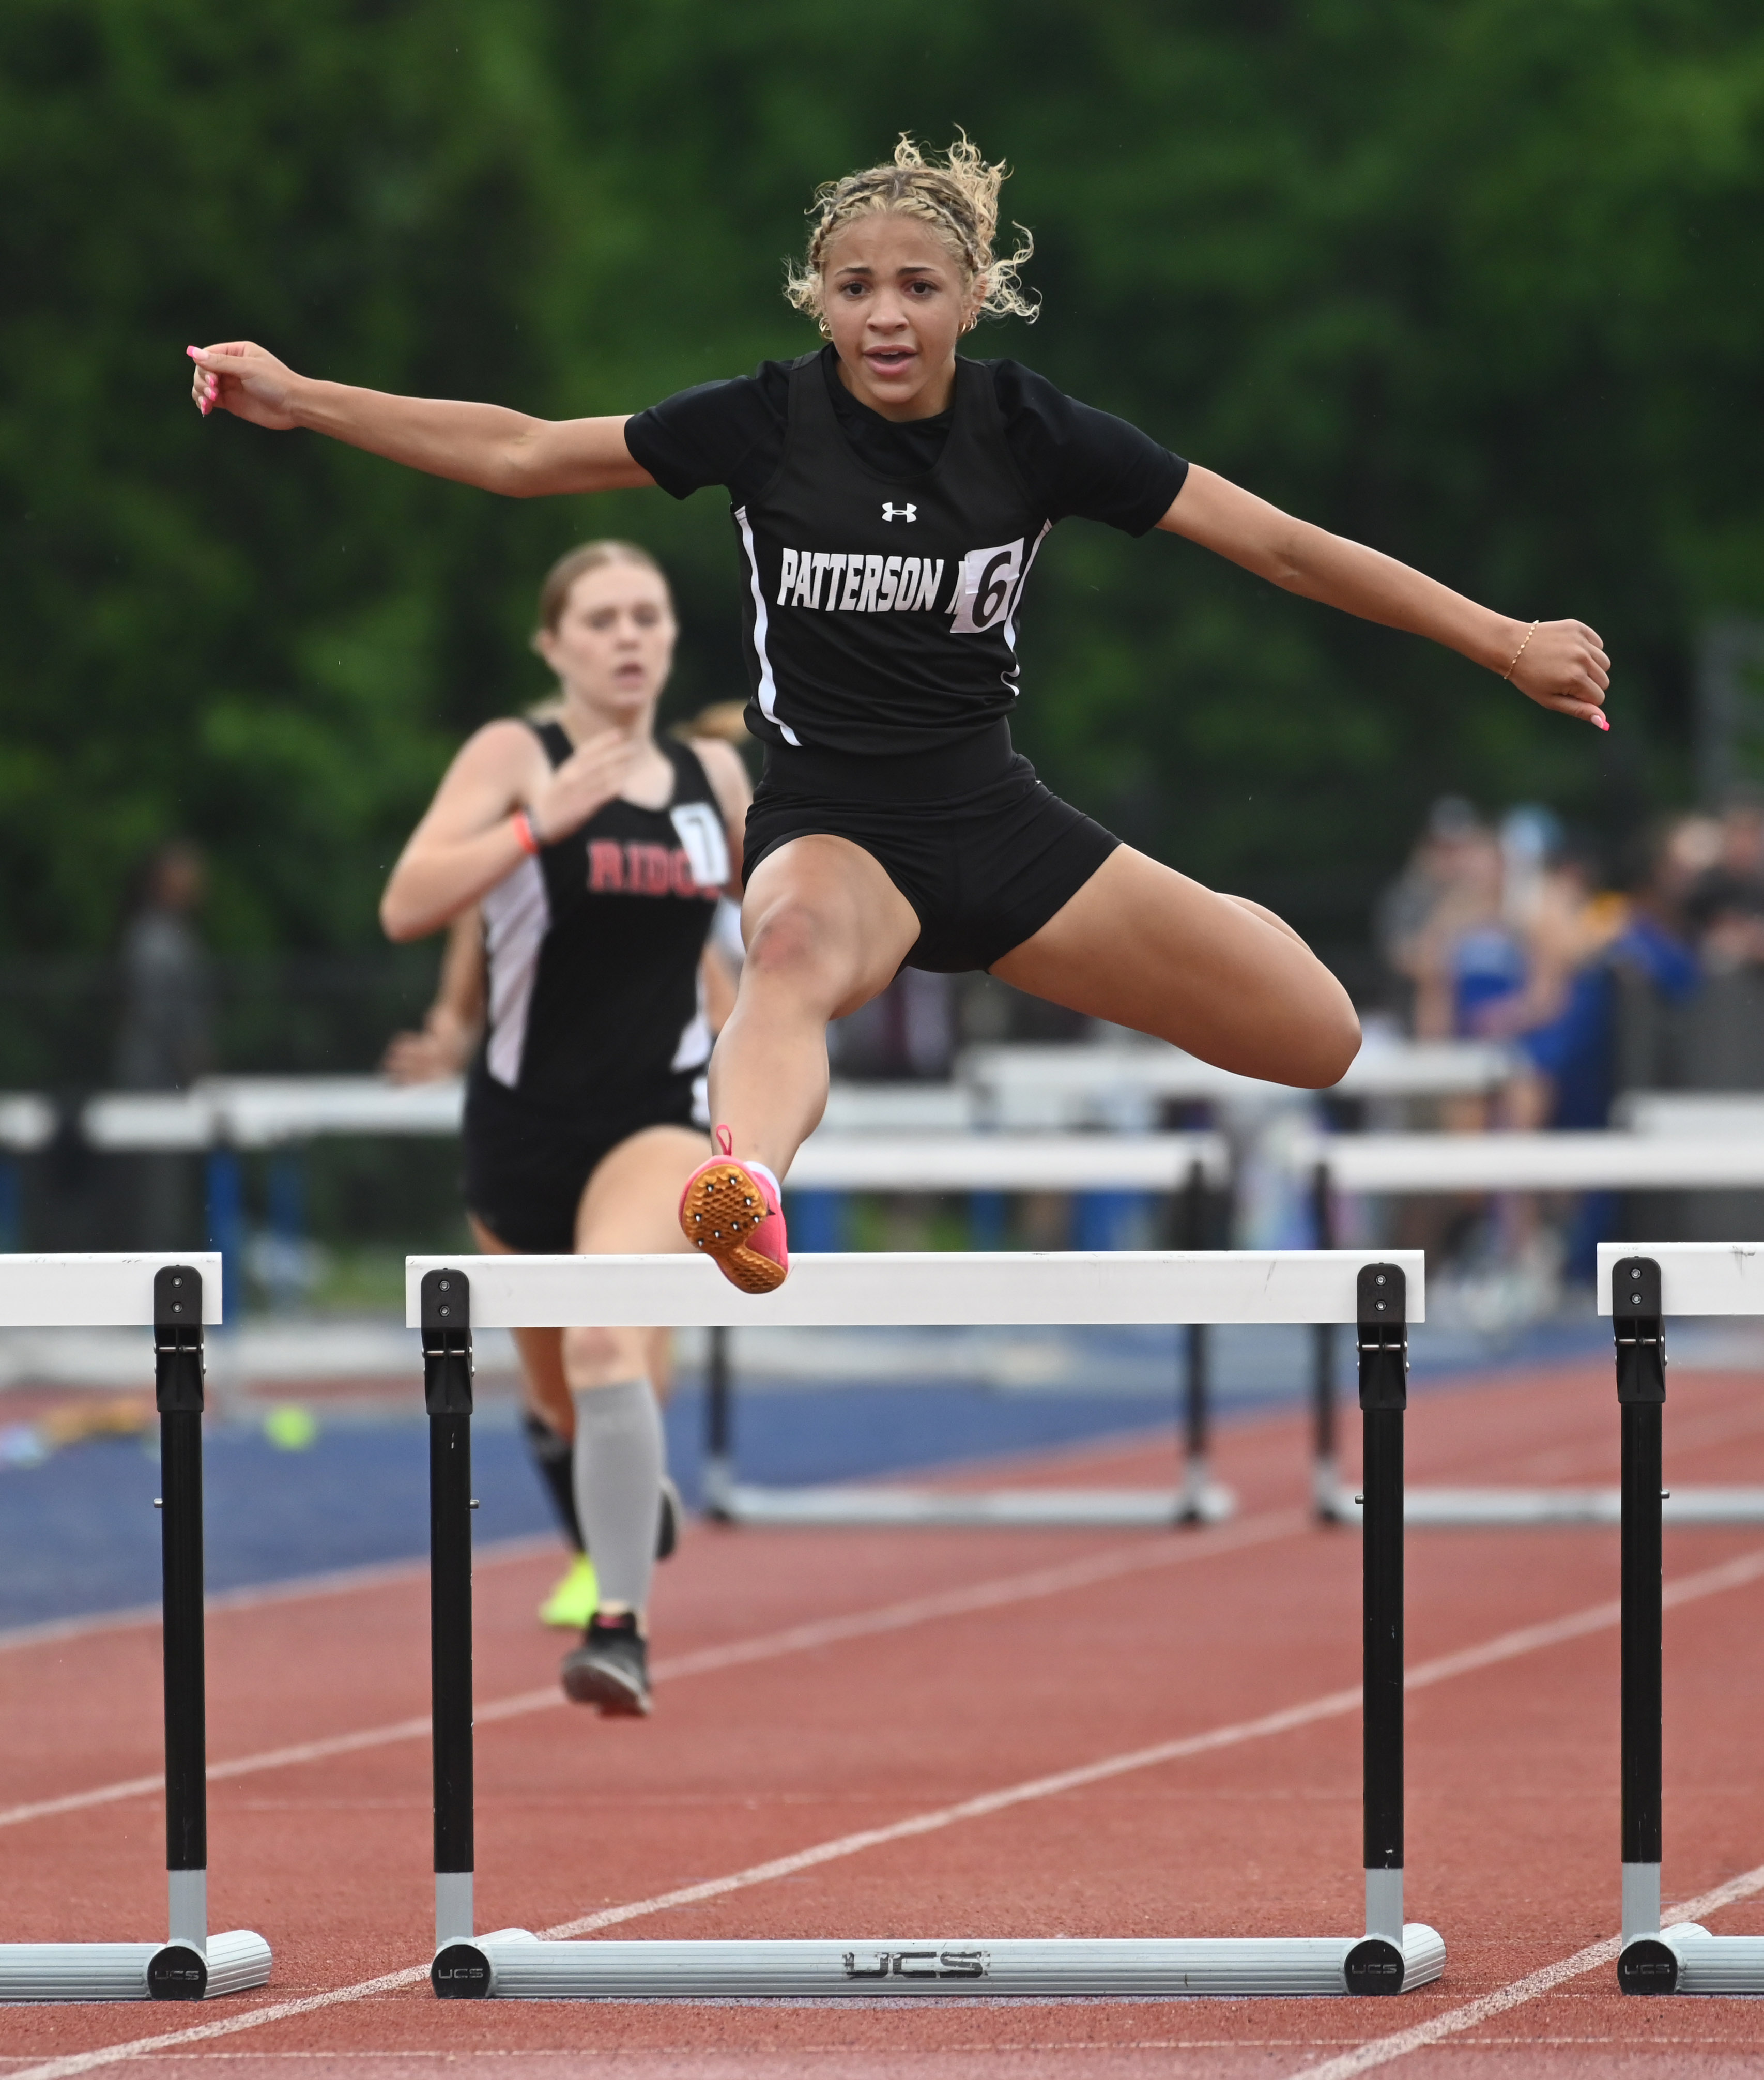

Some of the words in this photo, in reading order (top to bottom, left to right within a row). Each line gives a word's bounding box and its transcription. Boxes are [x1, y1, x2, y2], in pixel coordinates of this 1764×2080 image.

[777, 547, 944, 613] PATTERSON
[972, 550, 1012, 628] 6
[842, 1951, 984, 1980] UCS
[1351, 1964, 1397, 1975] UCS
[1624, 1964, 1670, 1975] UCS
[154, 1970, 200, 1980] UCS
[438, 1968, 484, 1979] UCS
